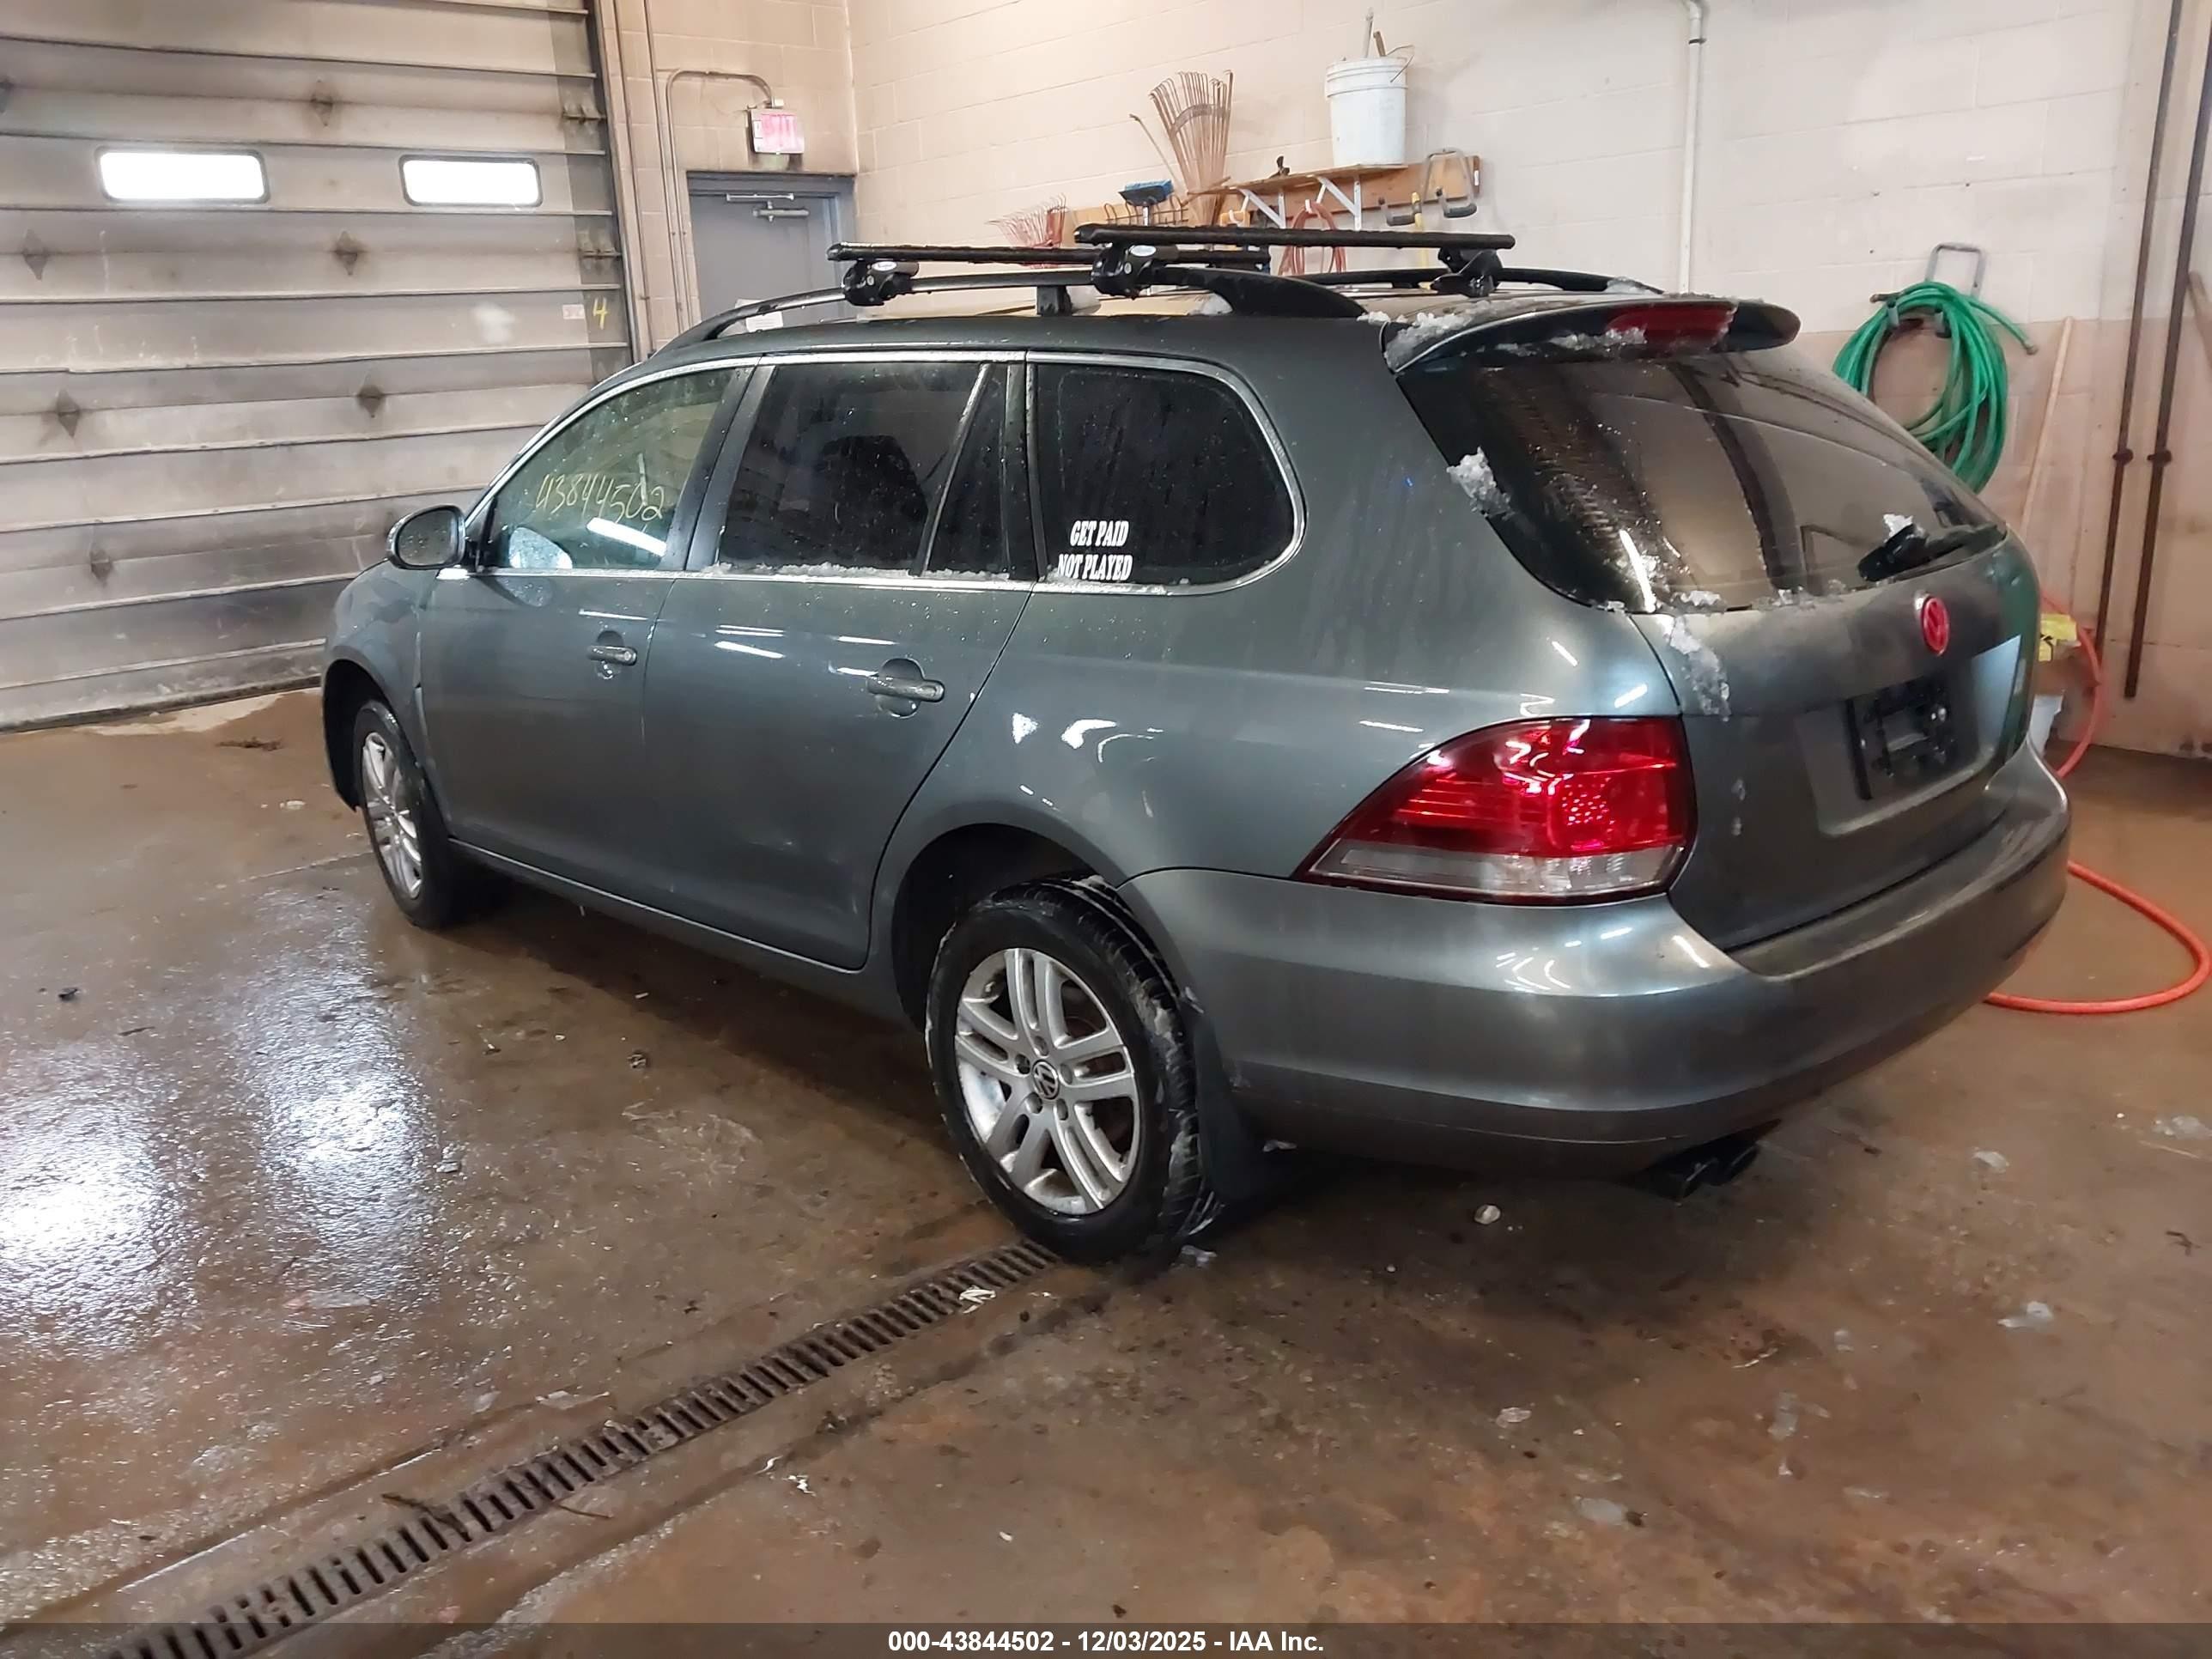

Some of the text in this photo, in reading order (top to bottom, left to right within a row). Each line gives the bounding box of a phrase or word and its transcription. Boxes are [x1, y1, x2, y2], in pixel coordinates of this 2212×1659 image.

[592, 297, 609, 330] 4
[535, 472, 665, 524] 43844502
[1069, 520, 1129, 547] GET PAID
[1057, 554, 1133, 580] NOT PLAYED
